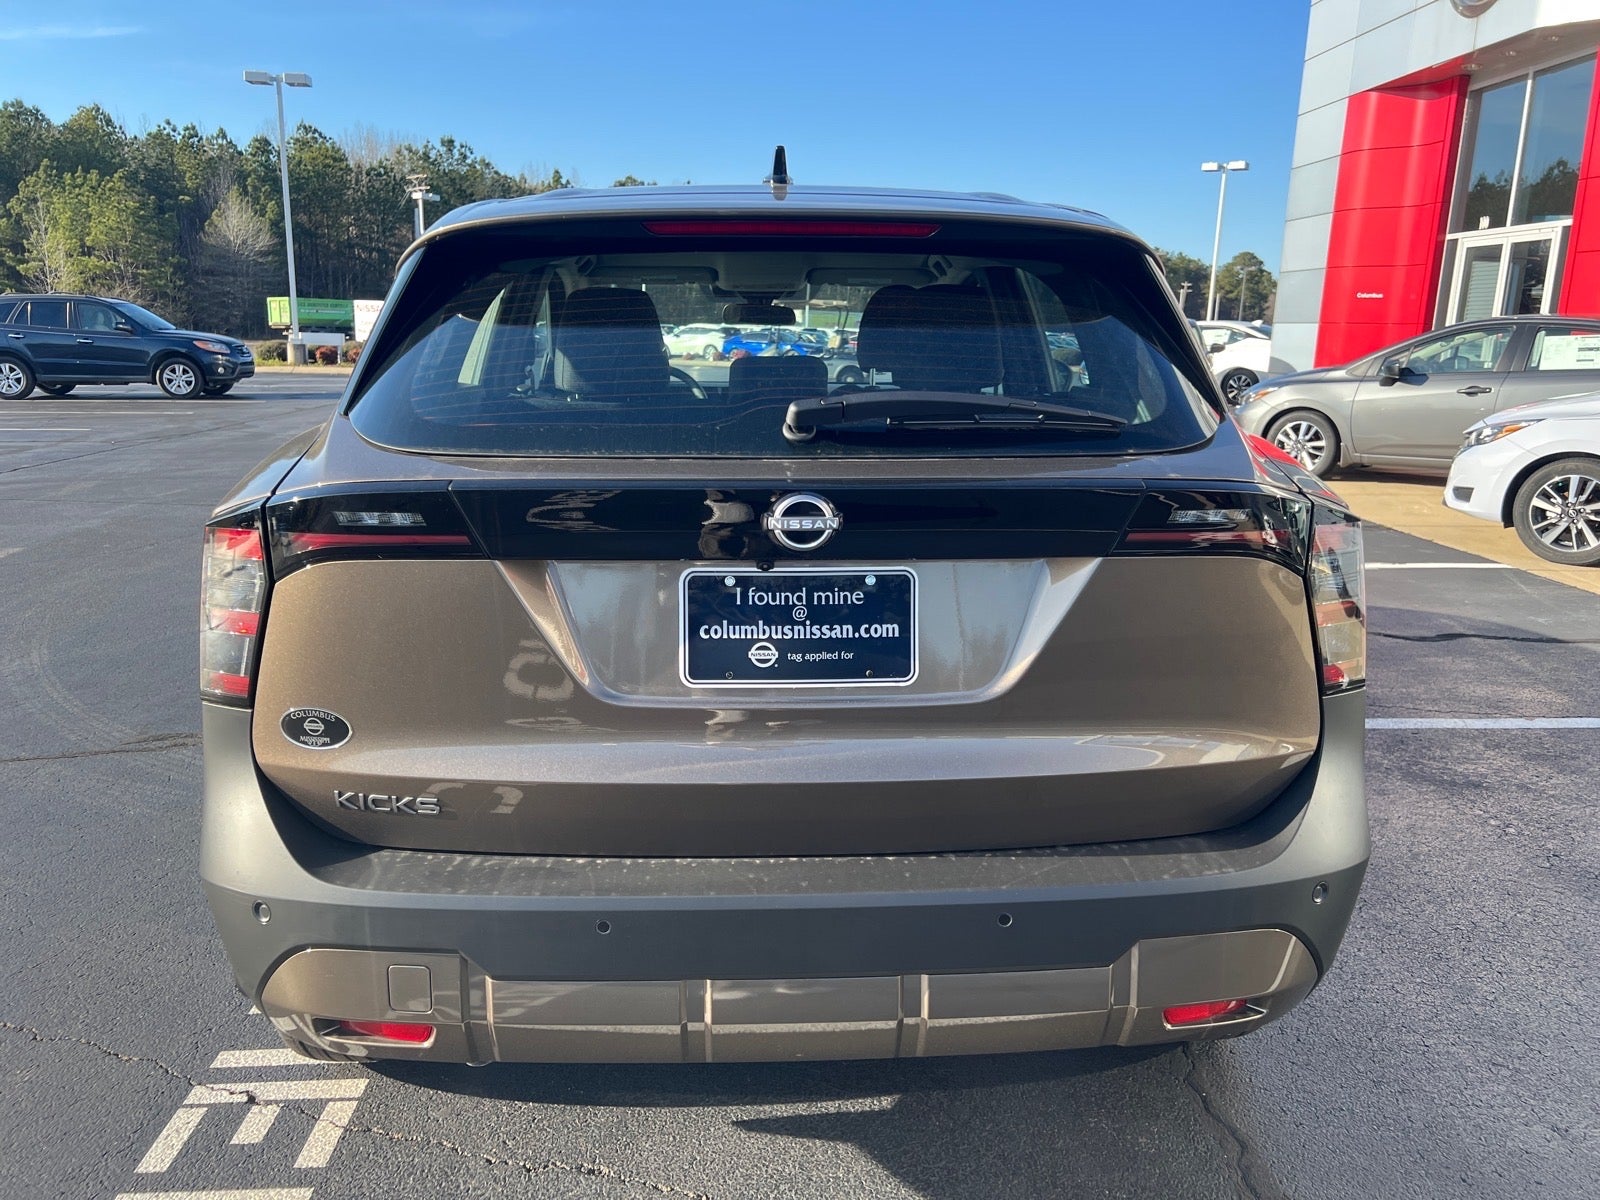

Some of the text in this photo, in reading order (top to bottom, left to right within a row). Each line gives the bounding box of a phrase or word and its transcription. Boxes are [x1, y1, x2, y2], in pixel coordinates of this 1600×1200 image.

[770, 519, 837, 529] NISSAN
[735, 587, 865, 606] I found mine
[792, 606, 808, 621] @
[699, 620, 900, 640] columbusnissan.com
[787, 650, 854, 662] tag applied for
[290, 710, 336, 722] COLUMBUS
[333, 790, 442, 815] KICKS
